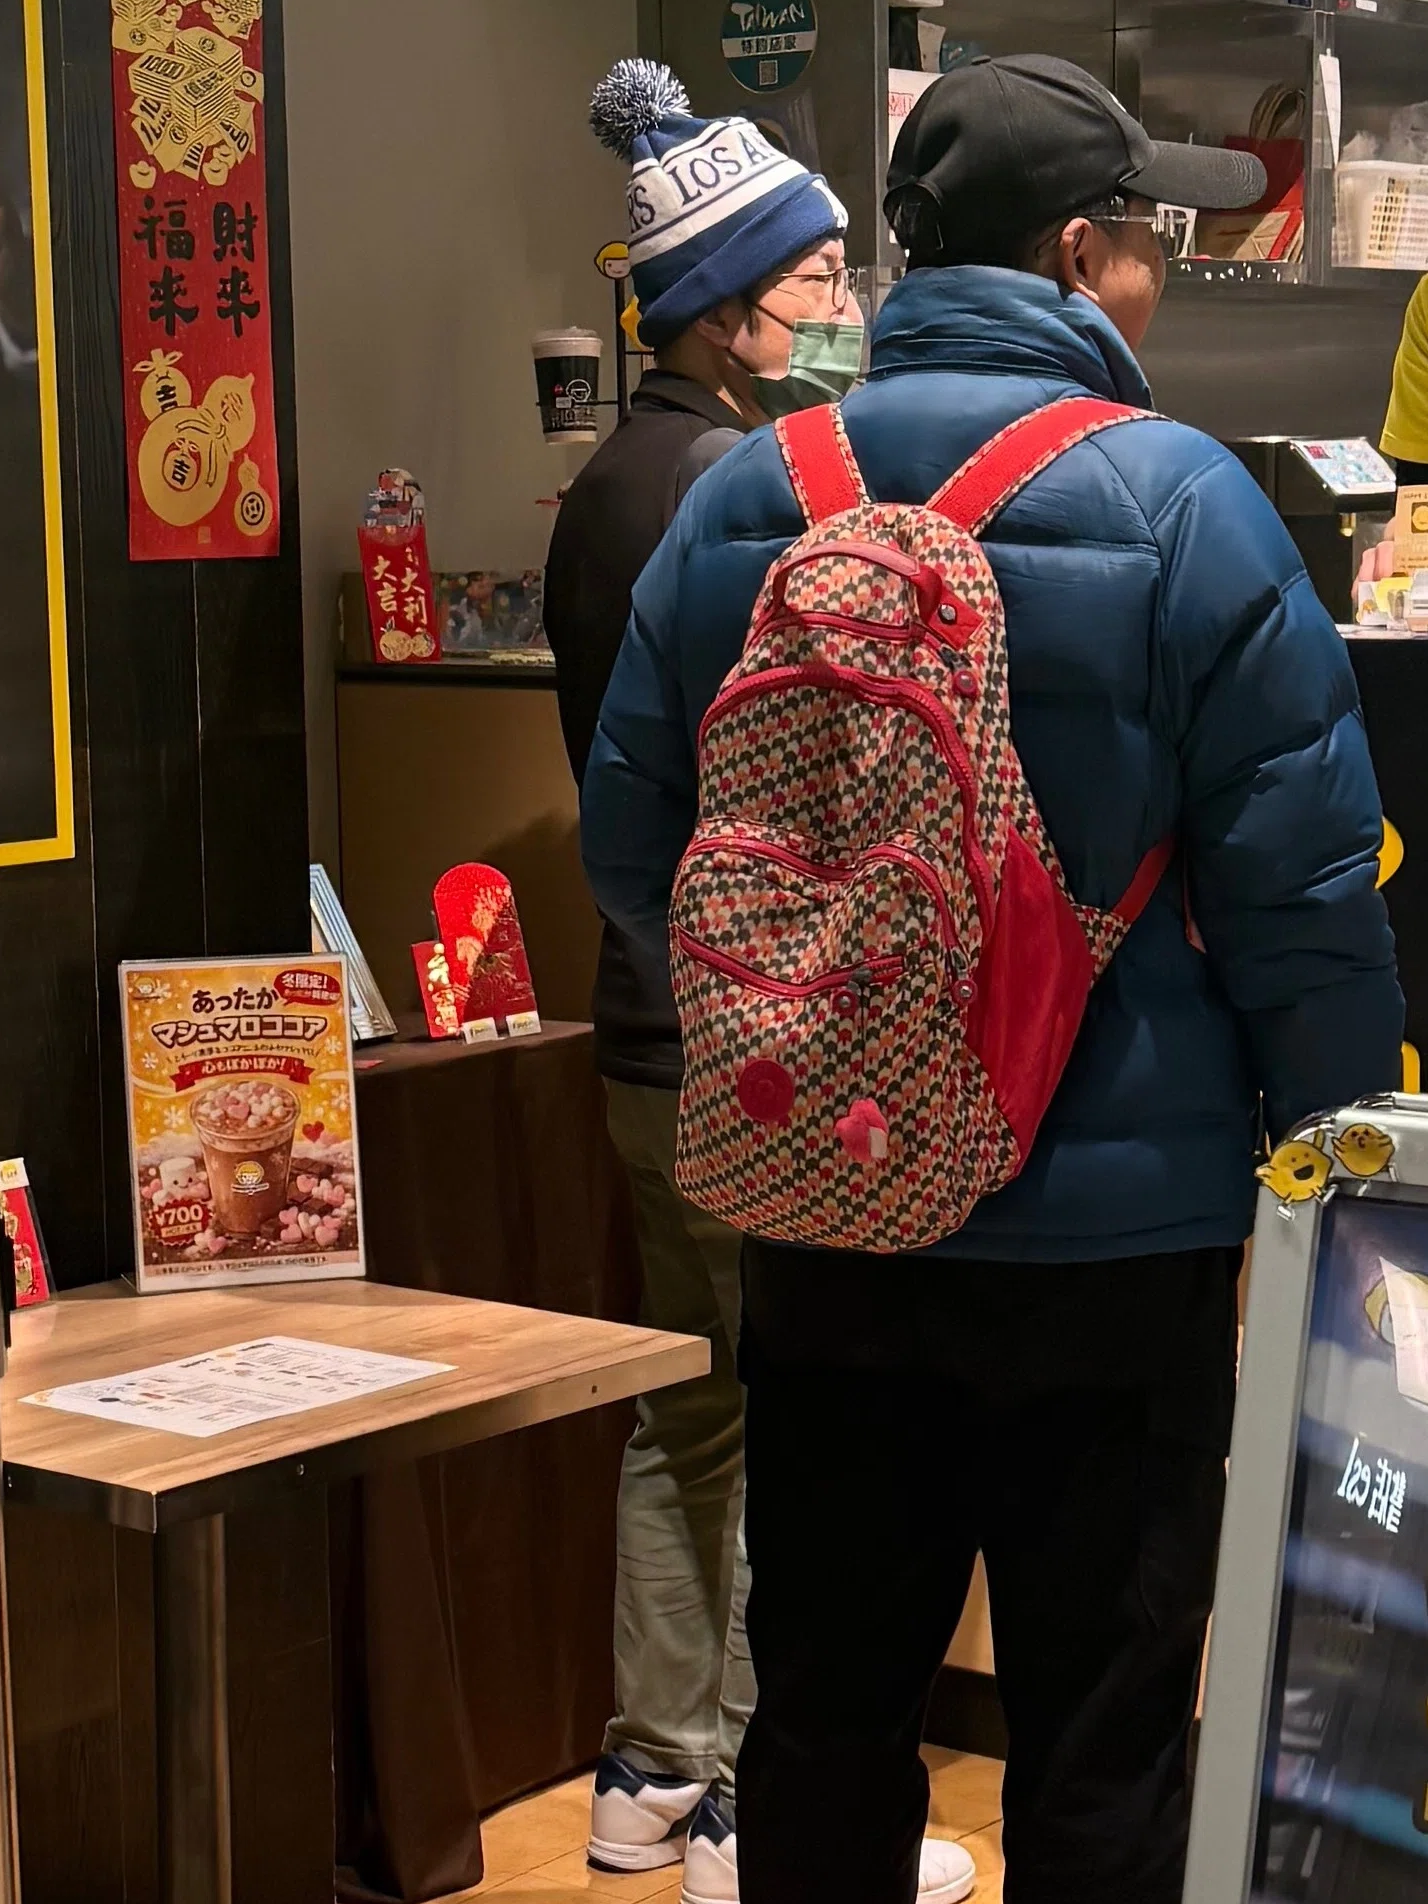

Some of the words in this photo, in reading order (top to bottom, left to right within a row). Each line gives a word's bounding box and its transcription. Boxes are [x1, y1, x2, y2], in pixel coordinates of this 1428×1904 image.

[667, 146, 743, 206] LOS
[191, 986, 279, 1014] あったか
[151, 1014, 328, 1048] マシュマロココア
